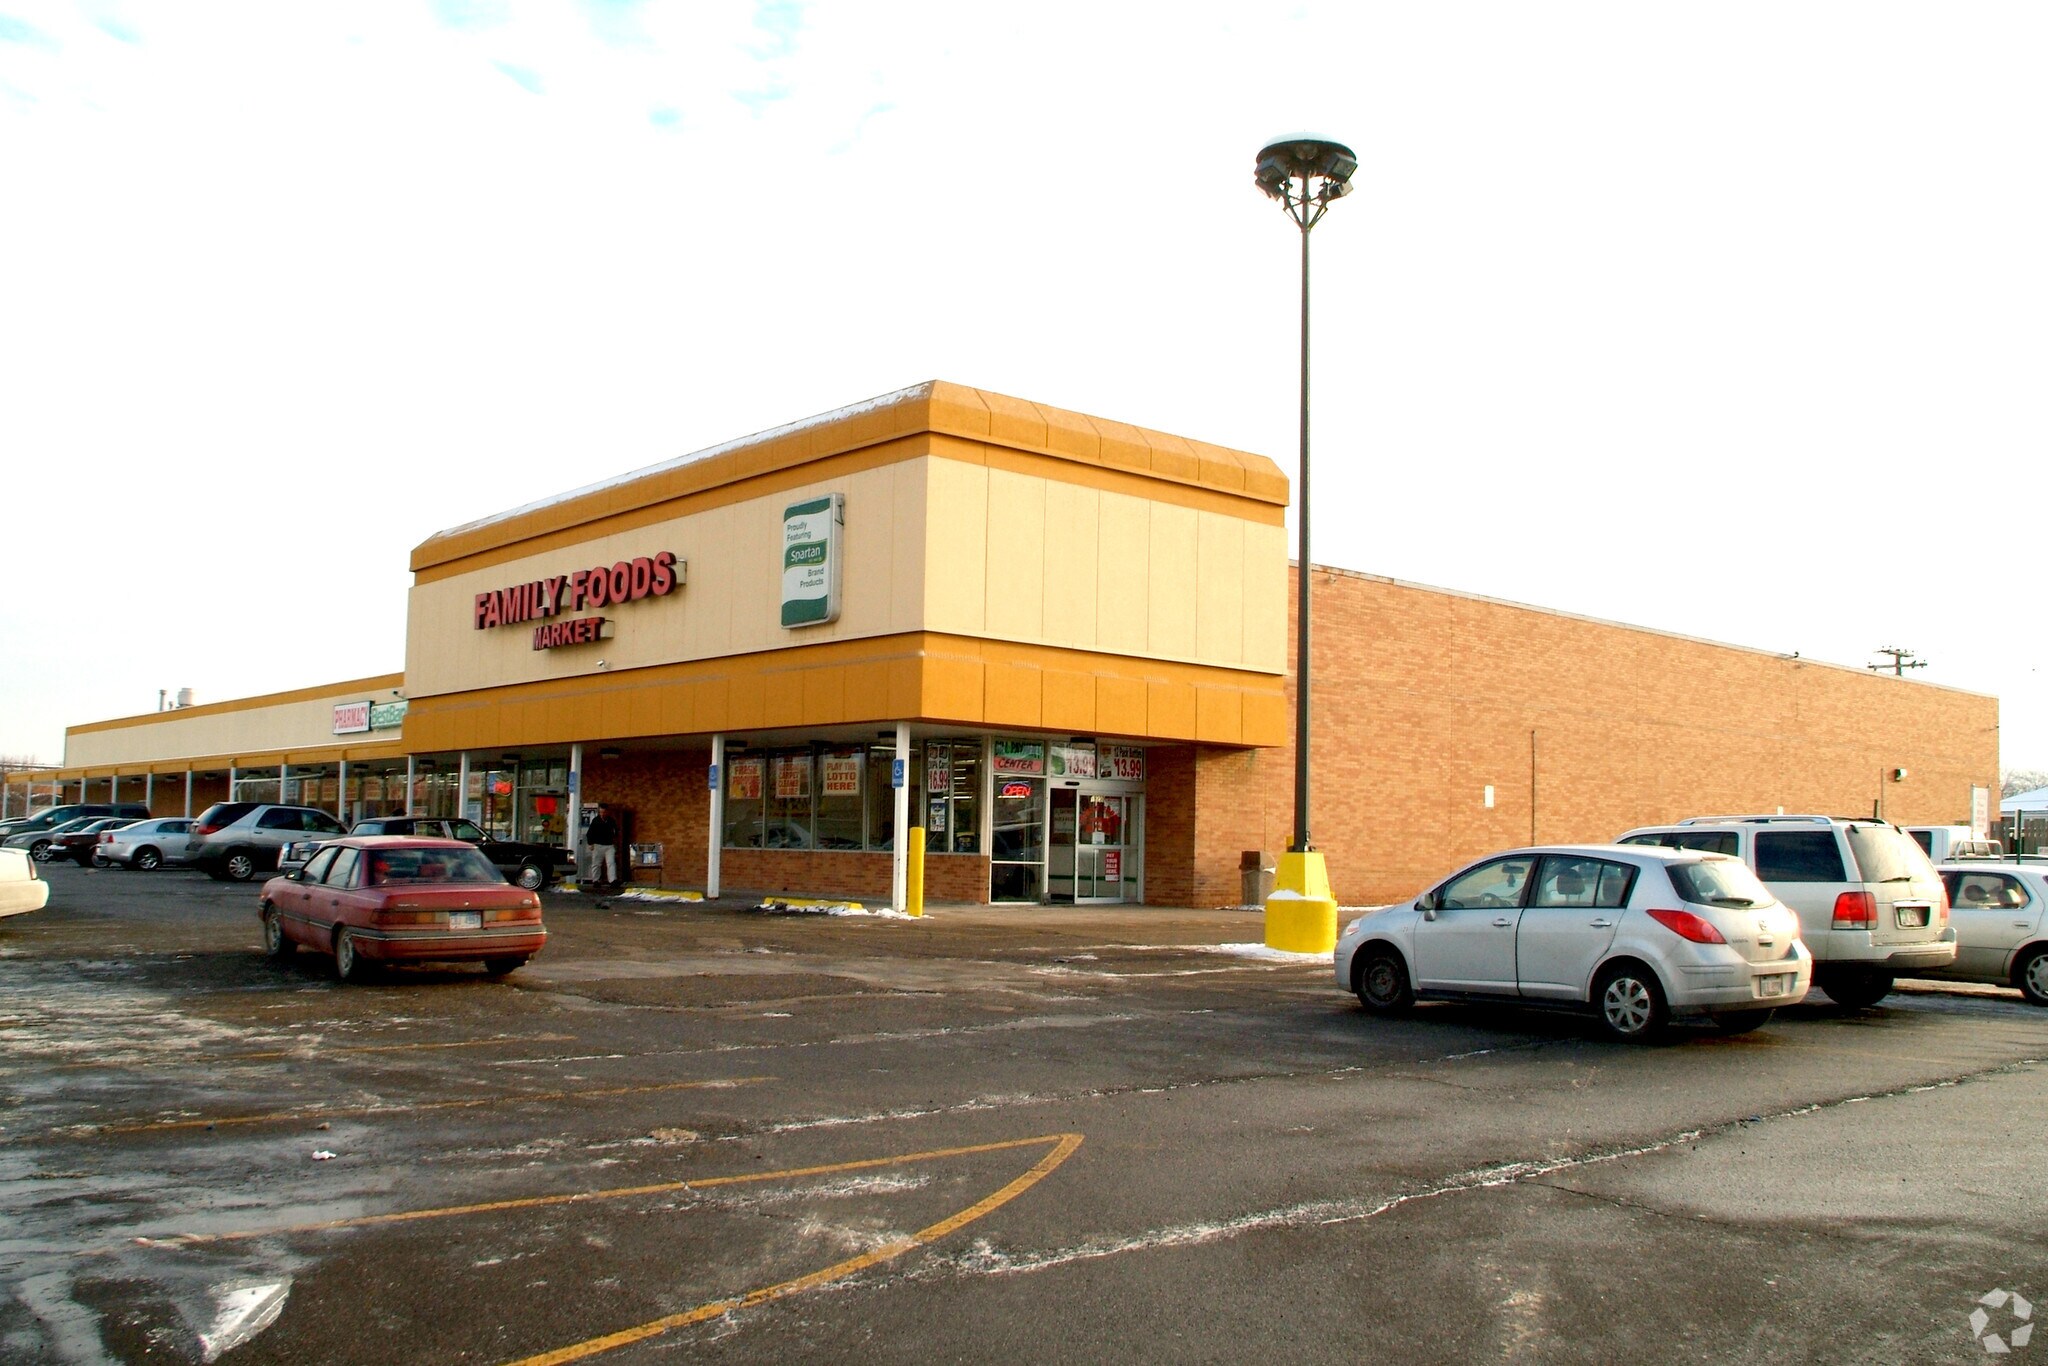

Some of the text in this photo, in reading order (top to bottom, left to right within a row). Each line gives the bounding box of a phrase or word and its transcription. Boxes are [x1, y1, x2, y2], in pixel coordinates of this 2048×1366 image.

[787, 521, 808, 532] Proudly
[787, 530, 812, 542] Featuring
[790, 546, 821, 563] Spartan
[808, 567, 824, 577] Brand
[800, 578, 824, 588] Products
[474, 551, 676, 630] FAMILY FOODS
[533, 617, 603, 651] MARKET
[335, 706, 368, 729] PHARMACY
[998, 758, 1034, 770] CENTER
[826, 772, 856, 781] LOTTO
[826, 782, 856, 790] HERE!
[1002, 784, 1031, 797] OPEN
